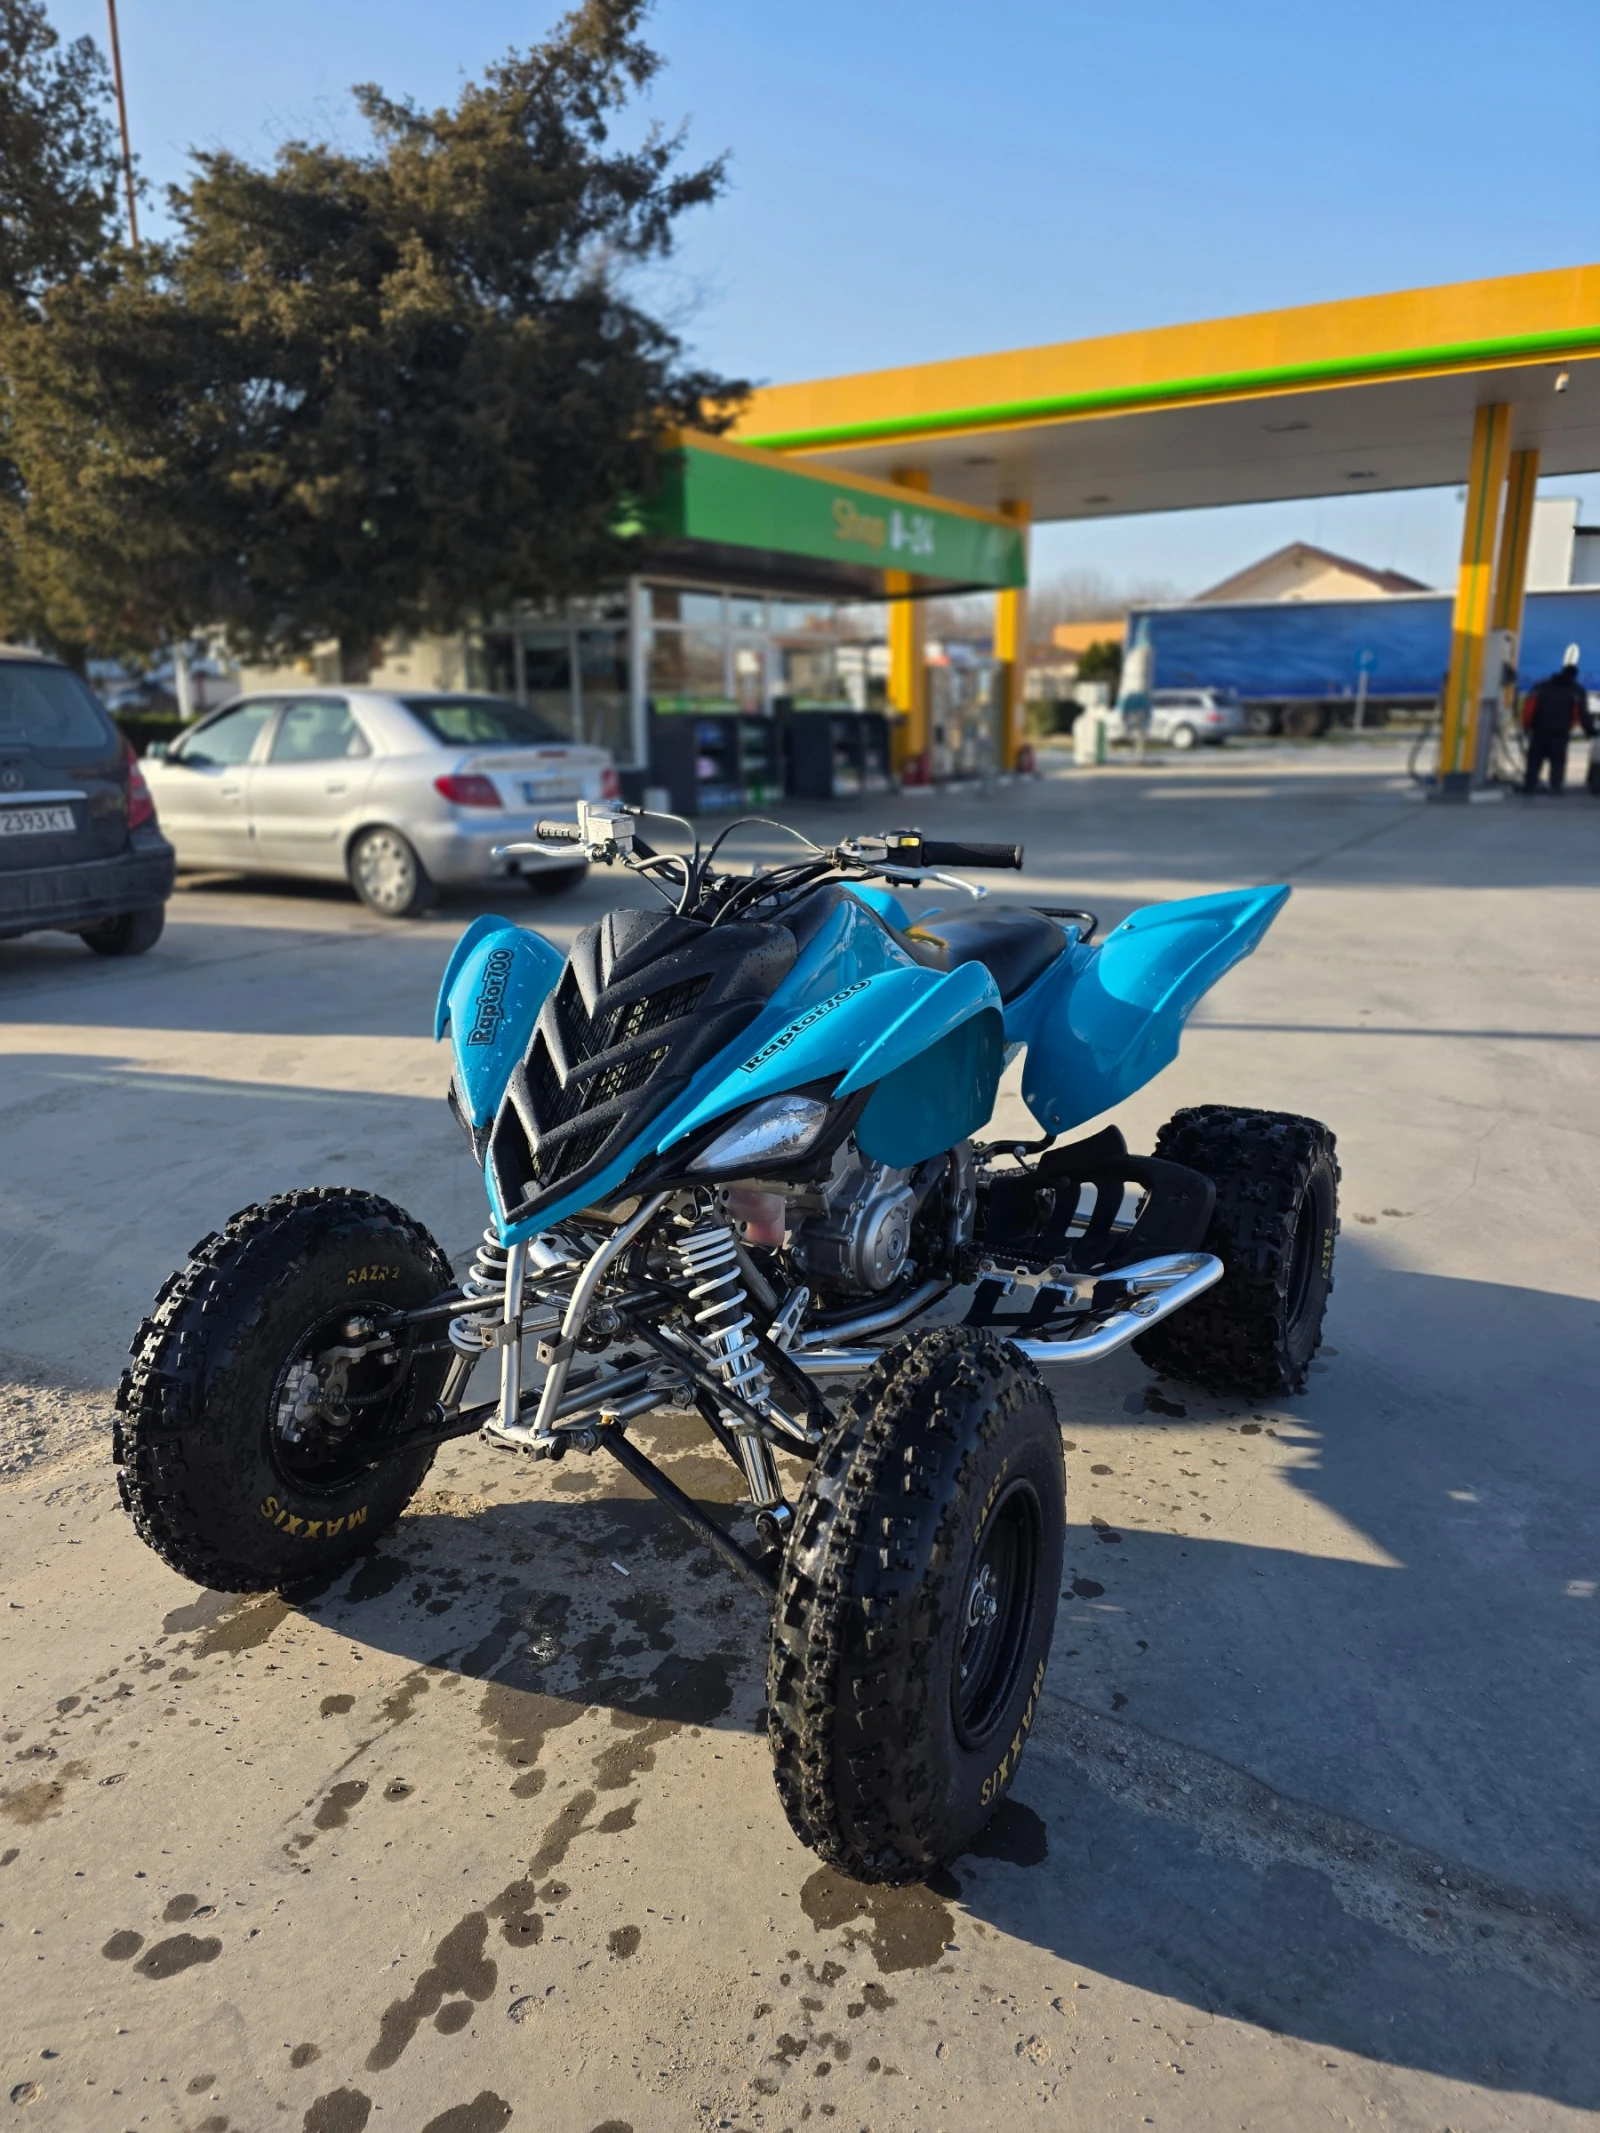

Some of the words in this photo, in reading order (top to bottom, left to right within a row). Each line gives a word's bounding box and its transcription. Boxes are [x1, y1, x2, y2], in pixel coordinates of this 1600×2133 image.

[467, 948, 514, 1046] Raptor700
[740, 980, 872, 1073] Raptor700
[346, 1265, 389, 1286] RAZR
[260, 1496, 368, 1539] MAXXIS
[980, 1658, 1045, 1807] MAXXIS
